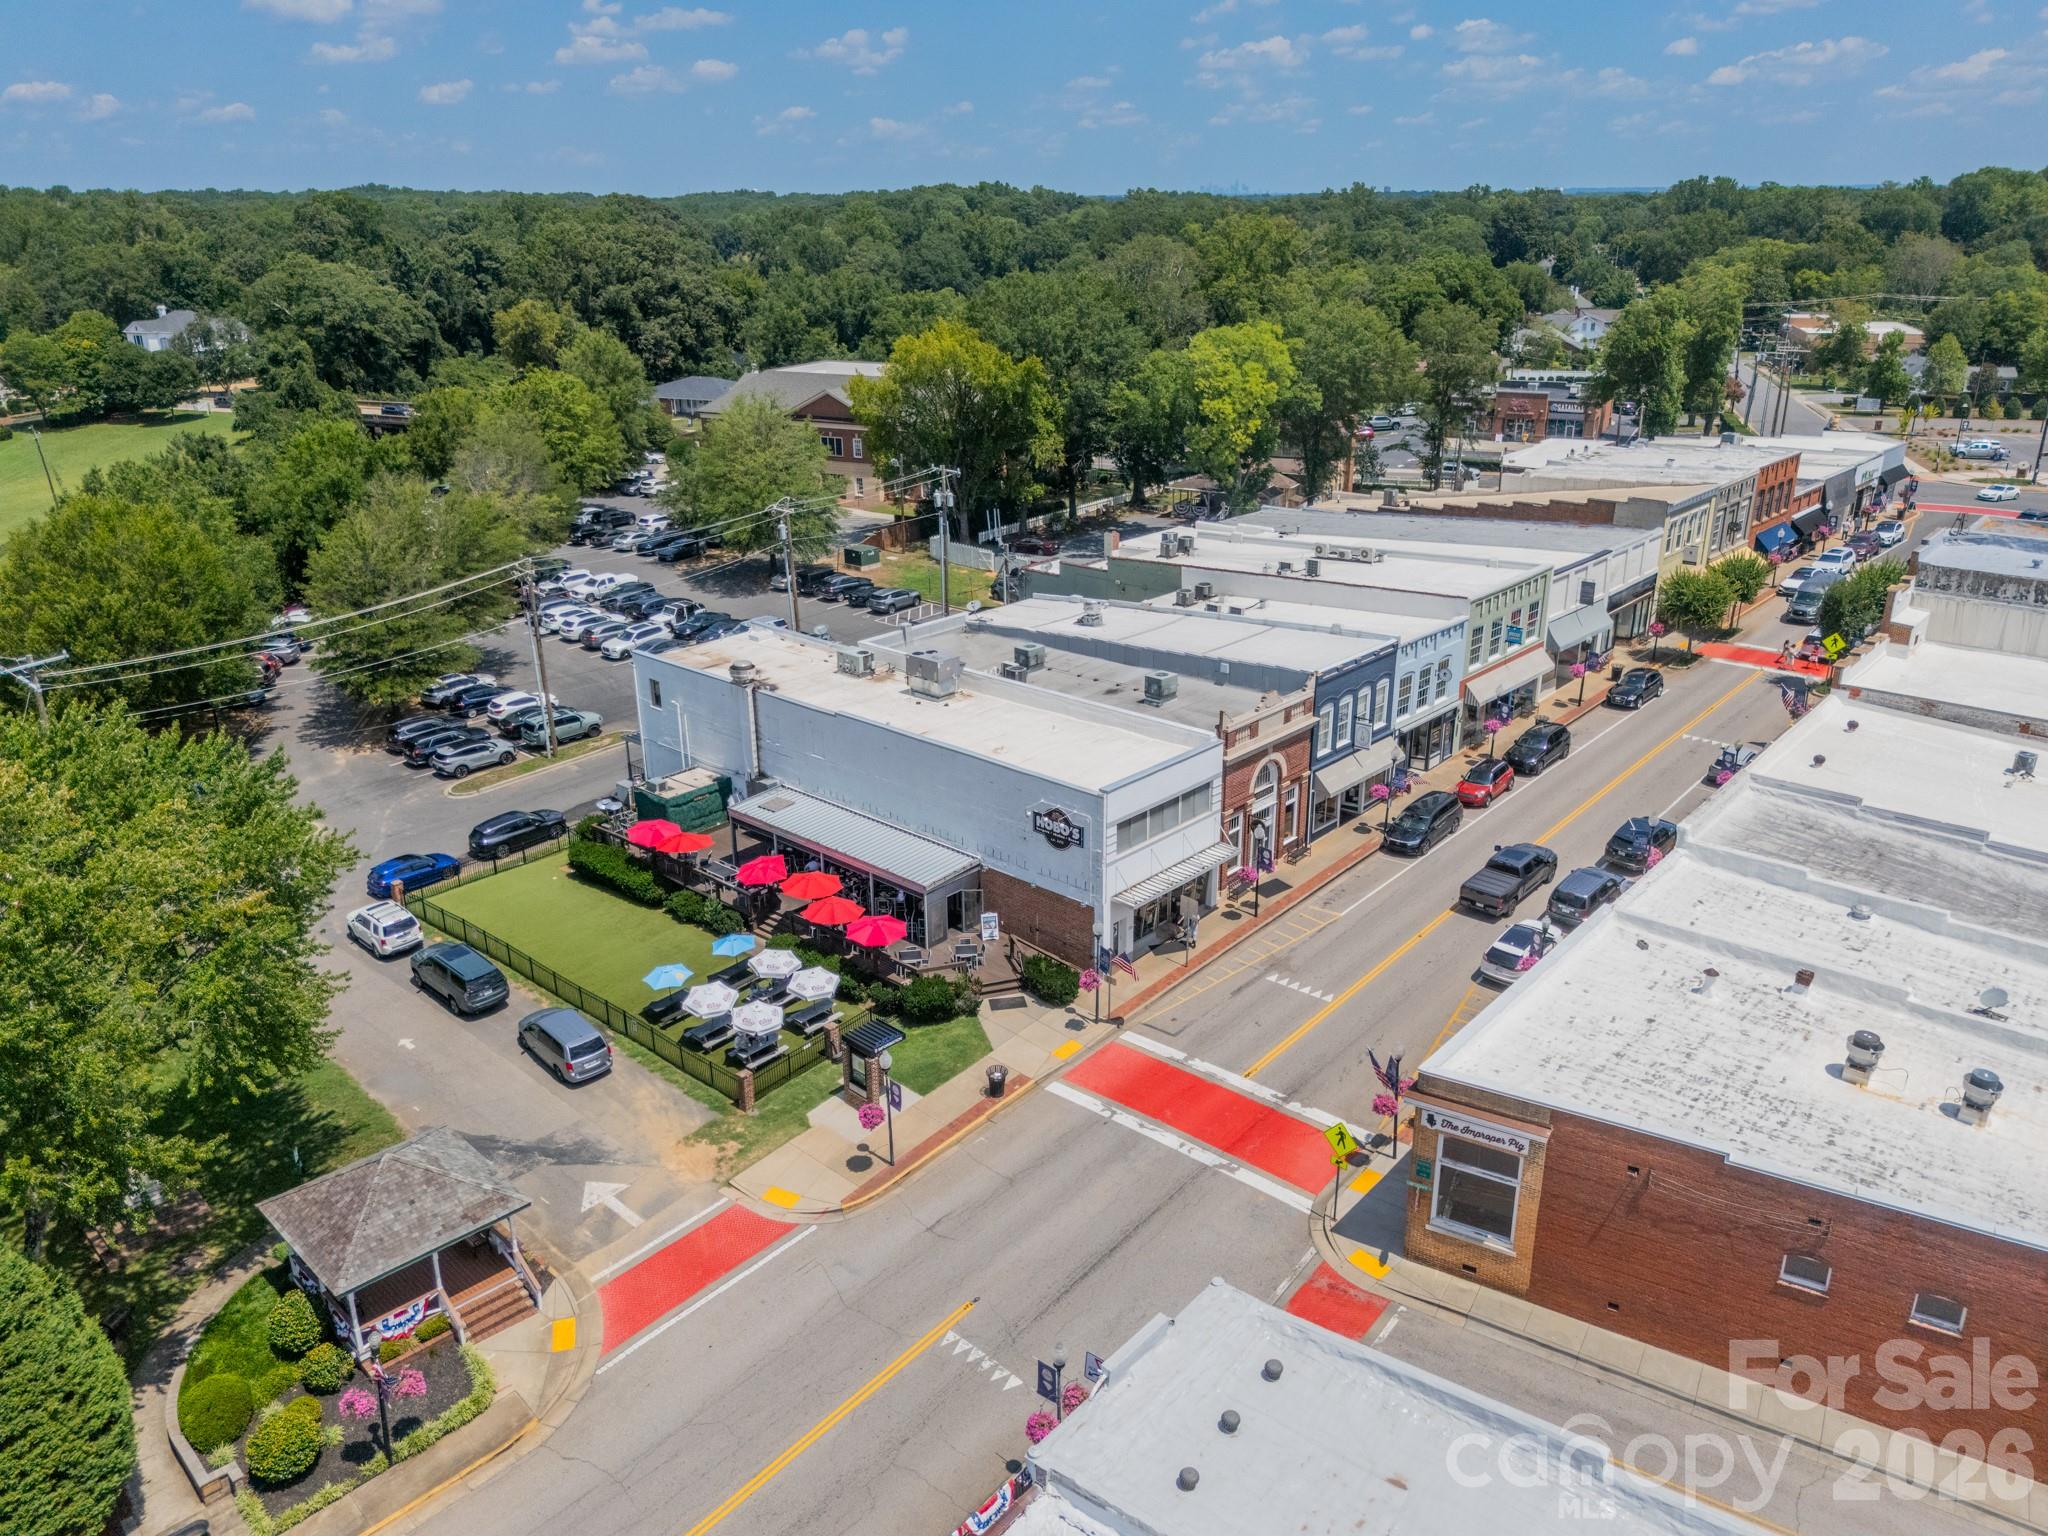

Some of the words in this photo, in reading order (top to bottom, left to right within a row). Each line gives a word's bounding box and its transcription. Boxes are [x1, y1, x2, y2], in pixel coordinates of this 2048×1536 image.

[1035, 815, 1080, 839] HOBO'S
[1441, 1119, 1459, 1132] The
[1460, 1126, 1506, 1145] Improper
[1507, 1138, 1525, 1152] Pig
